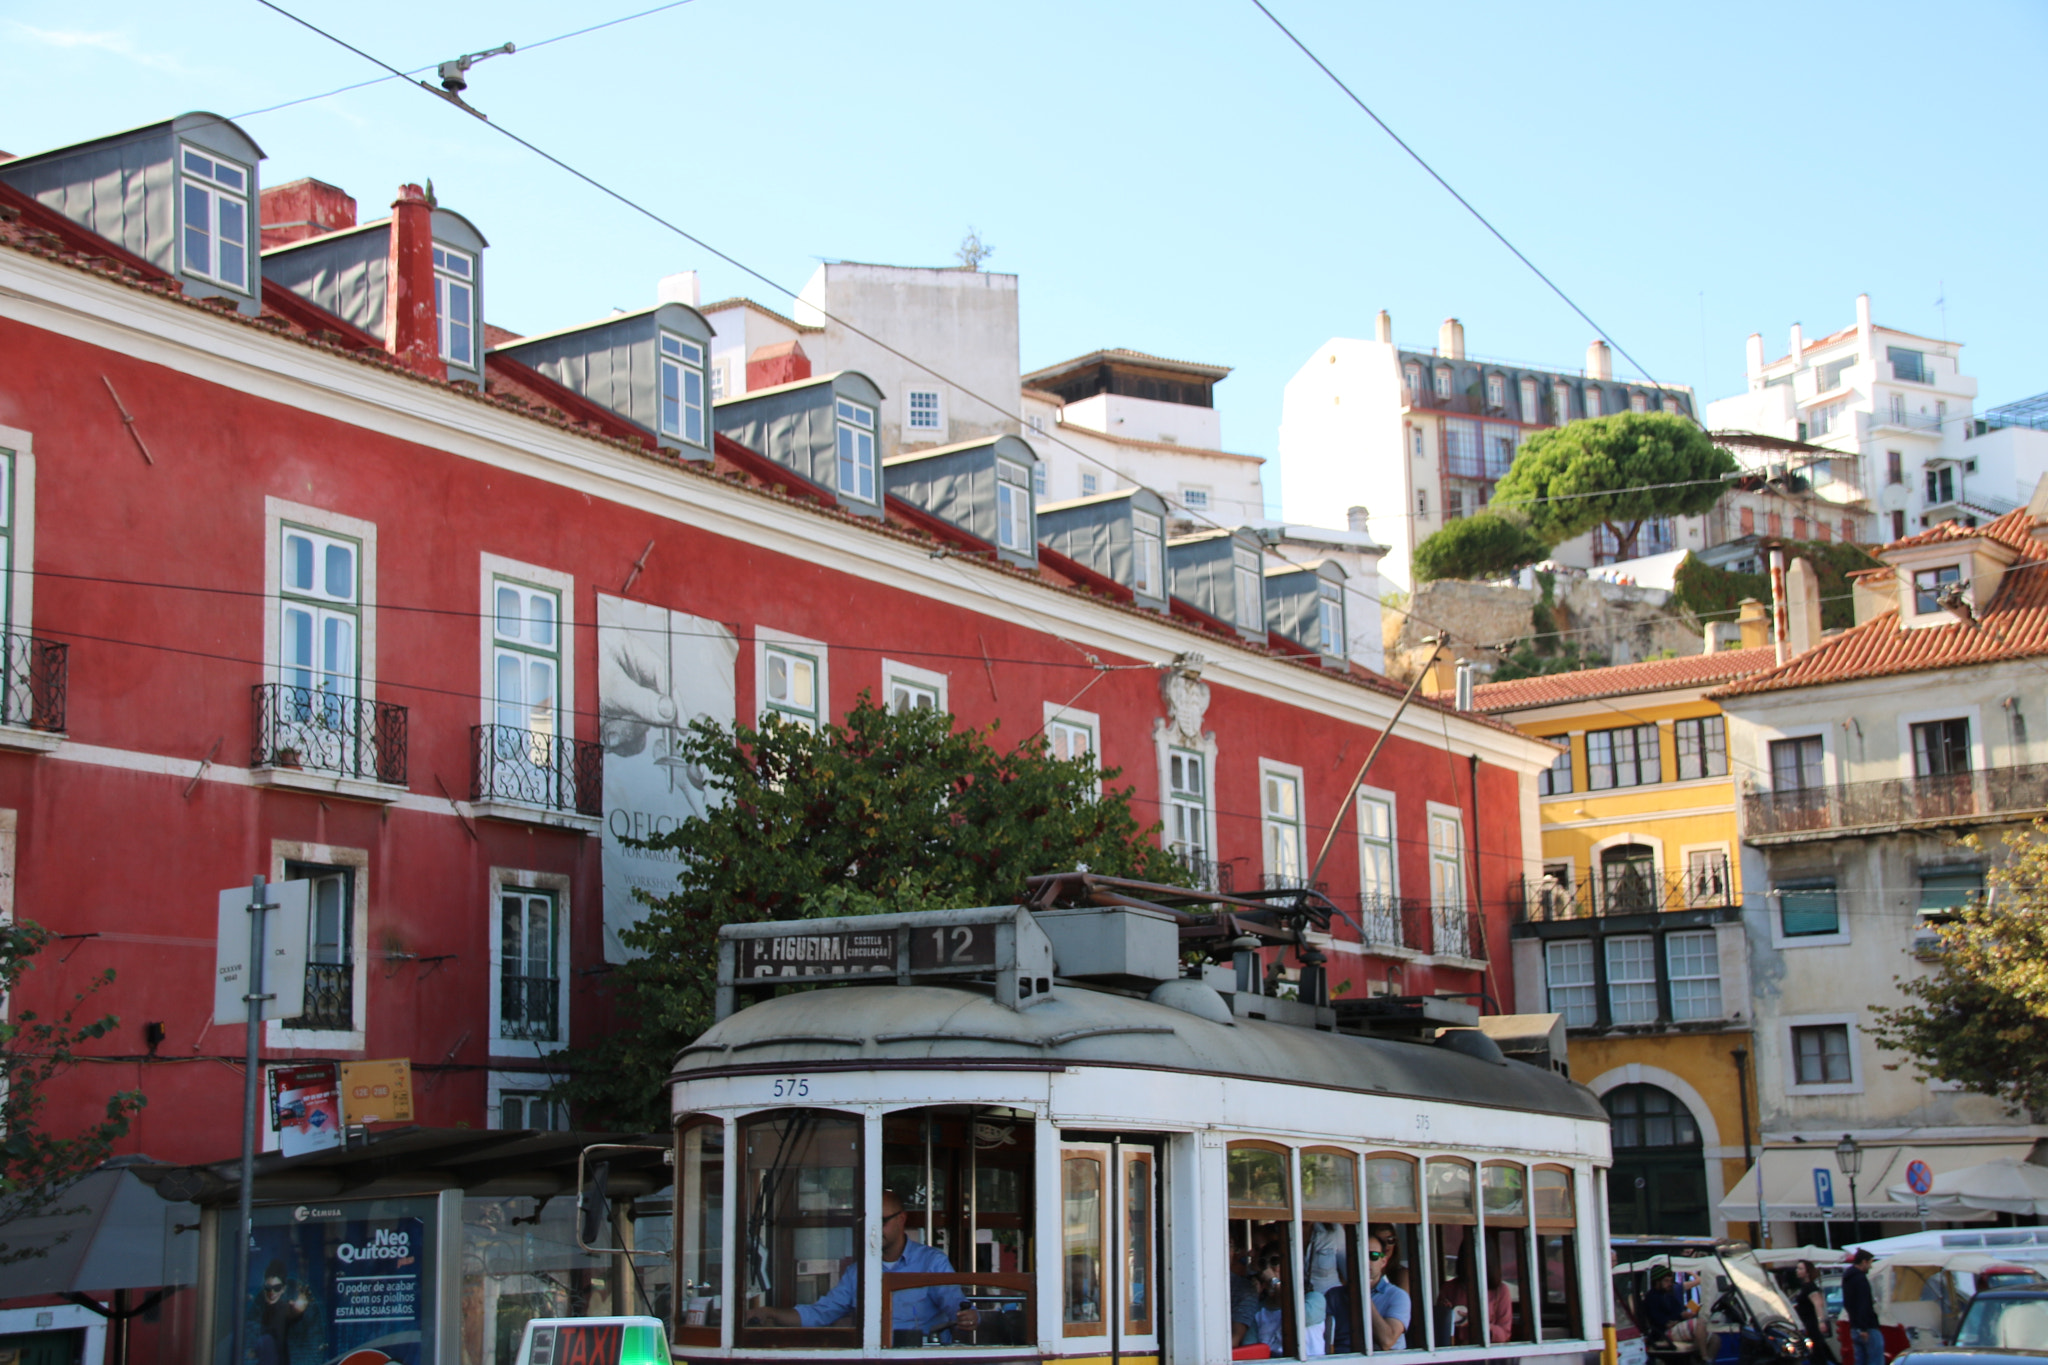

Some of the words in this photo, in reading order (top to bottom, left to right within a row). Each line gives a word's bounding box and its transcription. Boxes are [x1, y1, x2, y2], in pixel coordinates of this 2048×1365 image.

[753, 937, 768, 960] P.
[772, 936, 841, 960] FIGUEIRA
[932, 926, 974, 962] 12
[774, 1078, 809, 1097] 575
[1416, 1114, 1430, 1130] 575
[1817, 1172, 1829, 1203] P
[375, 1228, 409, 1246] Neo
[337, 1242, 409, 1264] Quitoso
[337, 1282, 345, 1294] O
[346, 1282, 372, 1296] poder
[373, 1281, 385, 1292] de
[386, 1280, 416, 1291] acabar
[351, 1295, 370, 1304] com
[371, 1294, 382, 1303] os
[383, 1291, 416, 1305] piolhos
[355, 1305, 370, 1316] NAS
[371, 1305, 391, 1315] SUAS
[561, 1326, 618, 1365] TAXI
